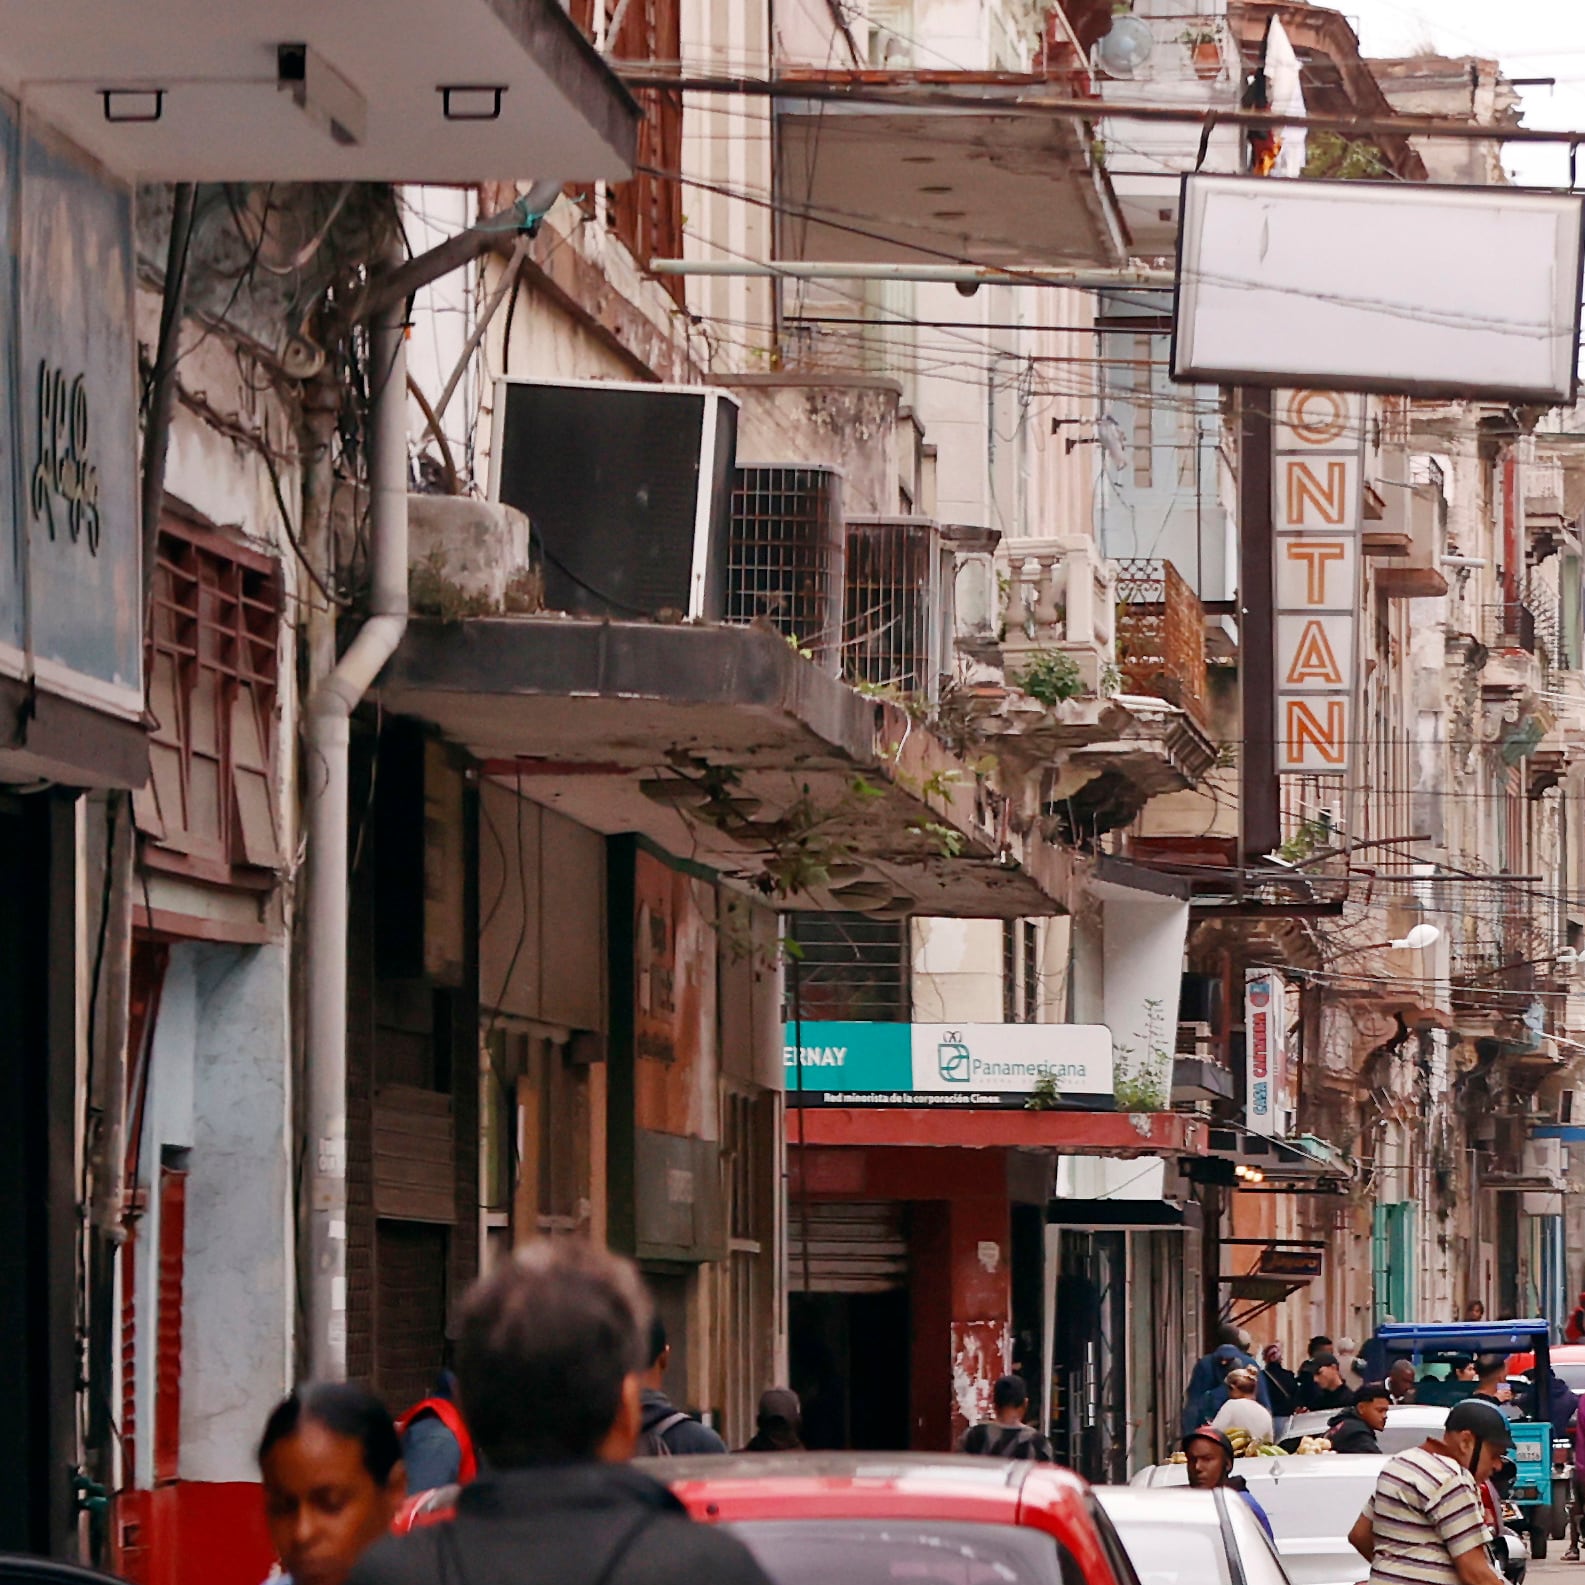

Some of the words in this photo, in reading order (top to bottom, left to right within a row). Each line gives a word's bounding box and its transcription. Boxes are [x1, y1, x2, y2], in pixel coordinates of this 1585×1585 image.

[972, 1058, 1086, 1078] Panamericana
[890, 1093, 902, 1103] de
[903, 1093, 913, 1103] la
[1253, 1081, 1267, 1115] CASA
